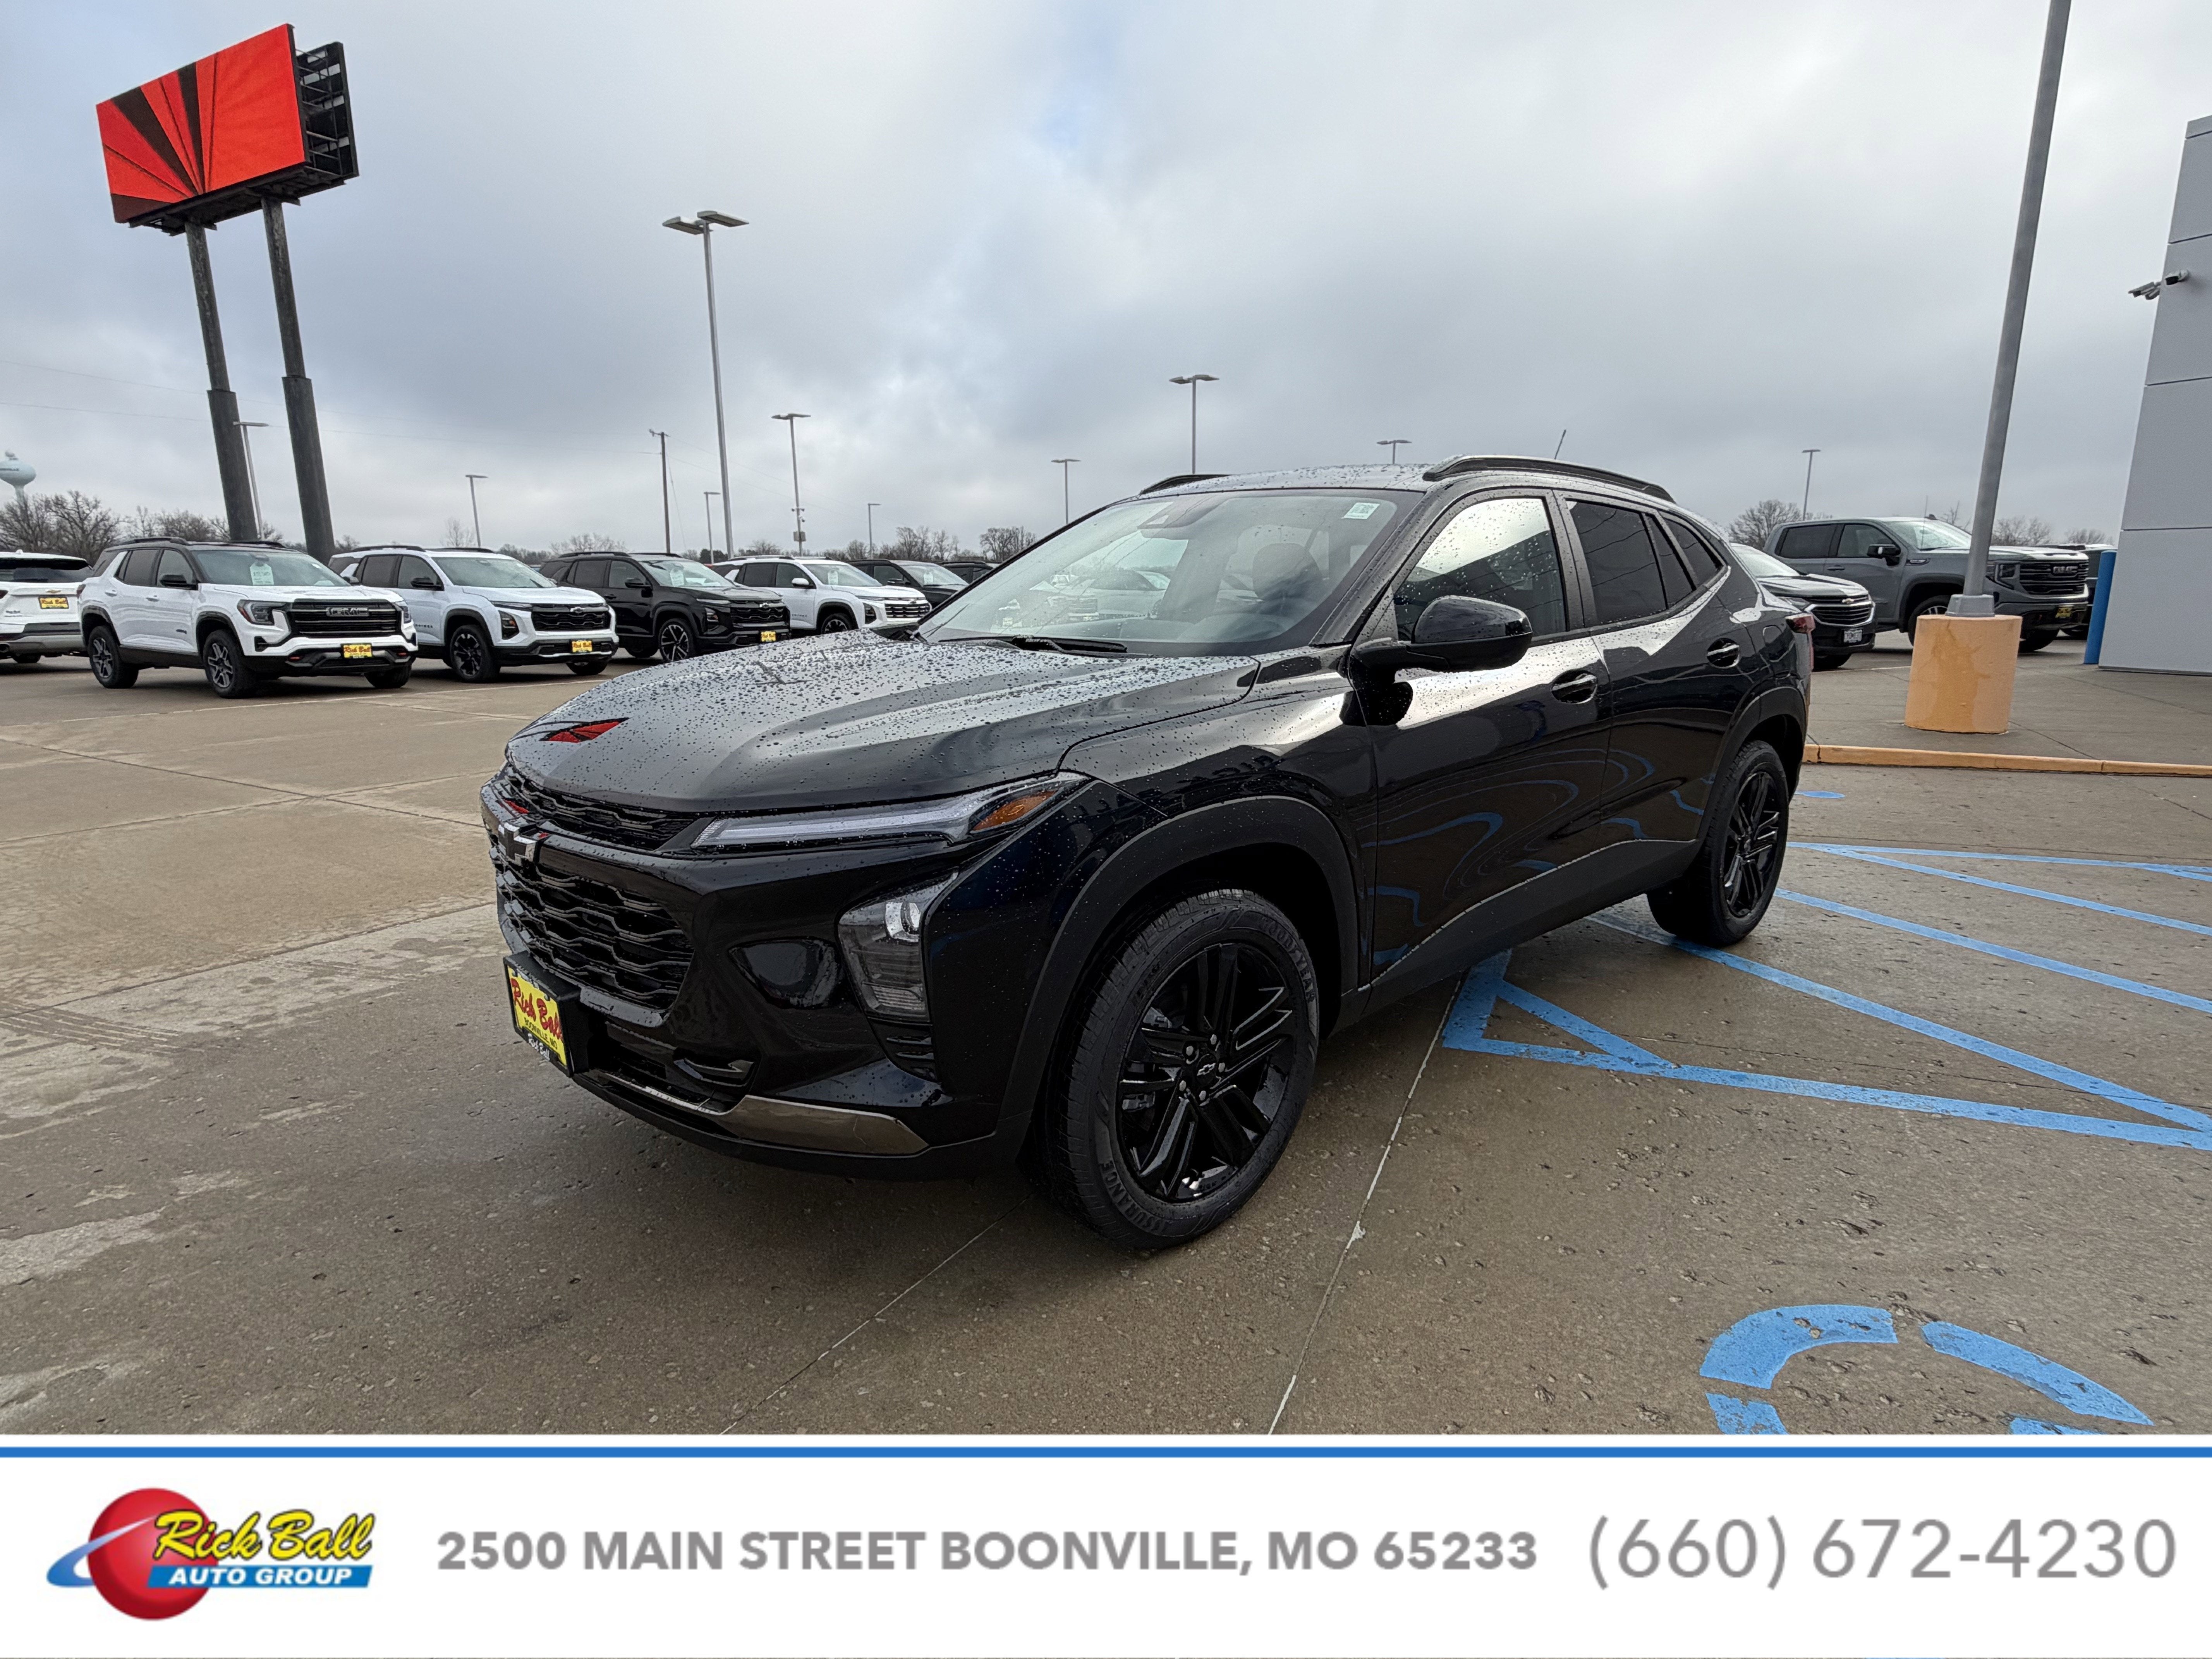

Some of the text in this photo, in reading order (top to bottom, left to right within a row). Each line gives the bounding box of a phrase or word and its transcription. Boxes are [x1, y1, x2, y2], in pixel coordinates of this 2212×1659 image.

[331, 608, 368, 617] GMC
[1258, 916, 1316, 1002] GOODYEAR
[510, 978, 564, 1041] Rick Ball
